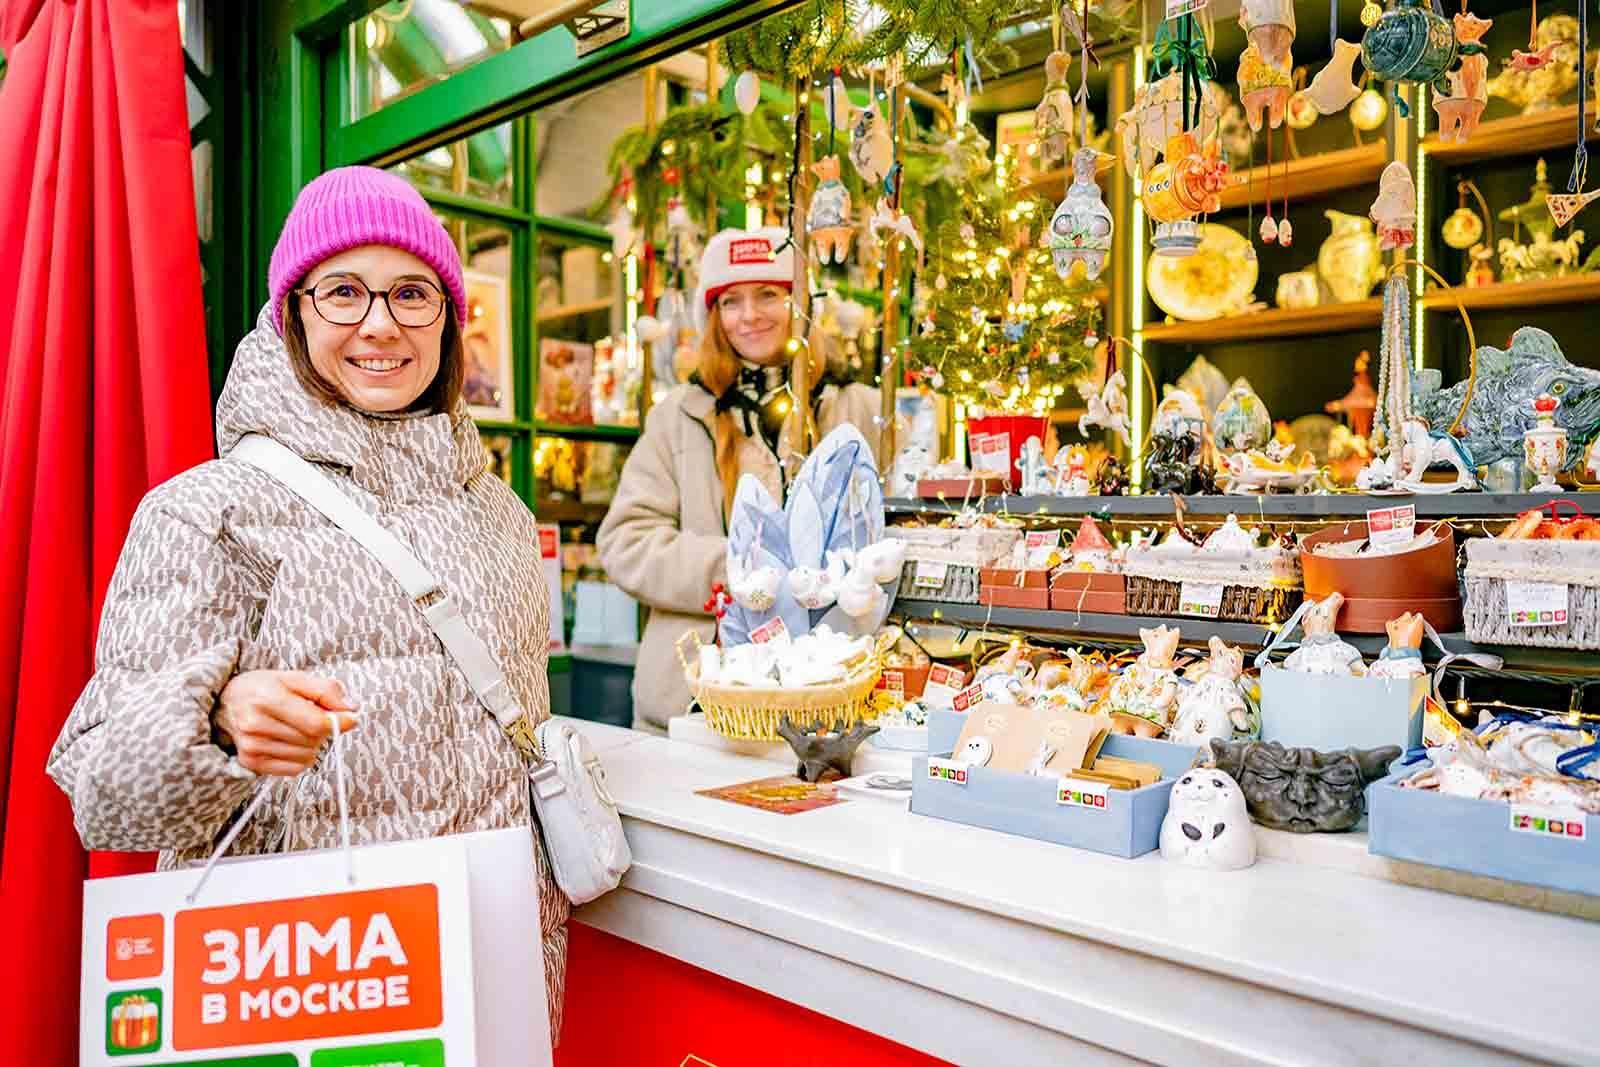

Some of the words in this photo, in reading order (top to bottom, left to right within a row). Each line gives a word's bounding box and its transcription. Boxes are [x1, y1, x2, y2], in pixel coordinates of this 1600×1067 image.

[201, 912, 409, 985] ЗИМА
[201, 993, 228, 1025] В
[239, 974, 411, 1022] МОСКВЕ
